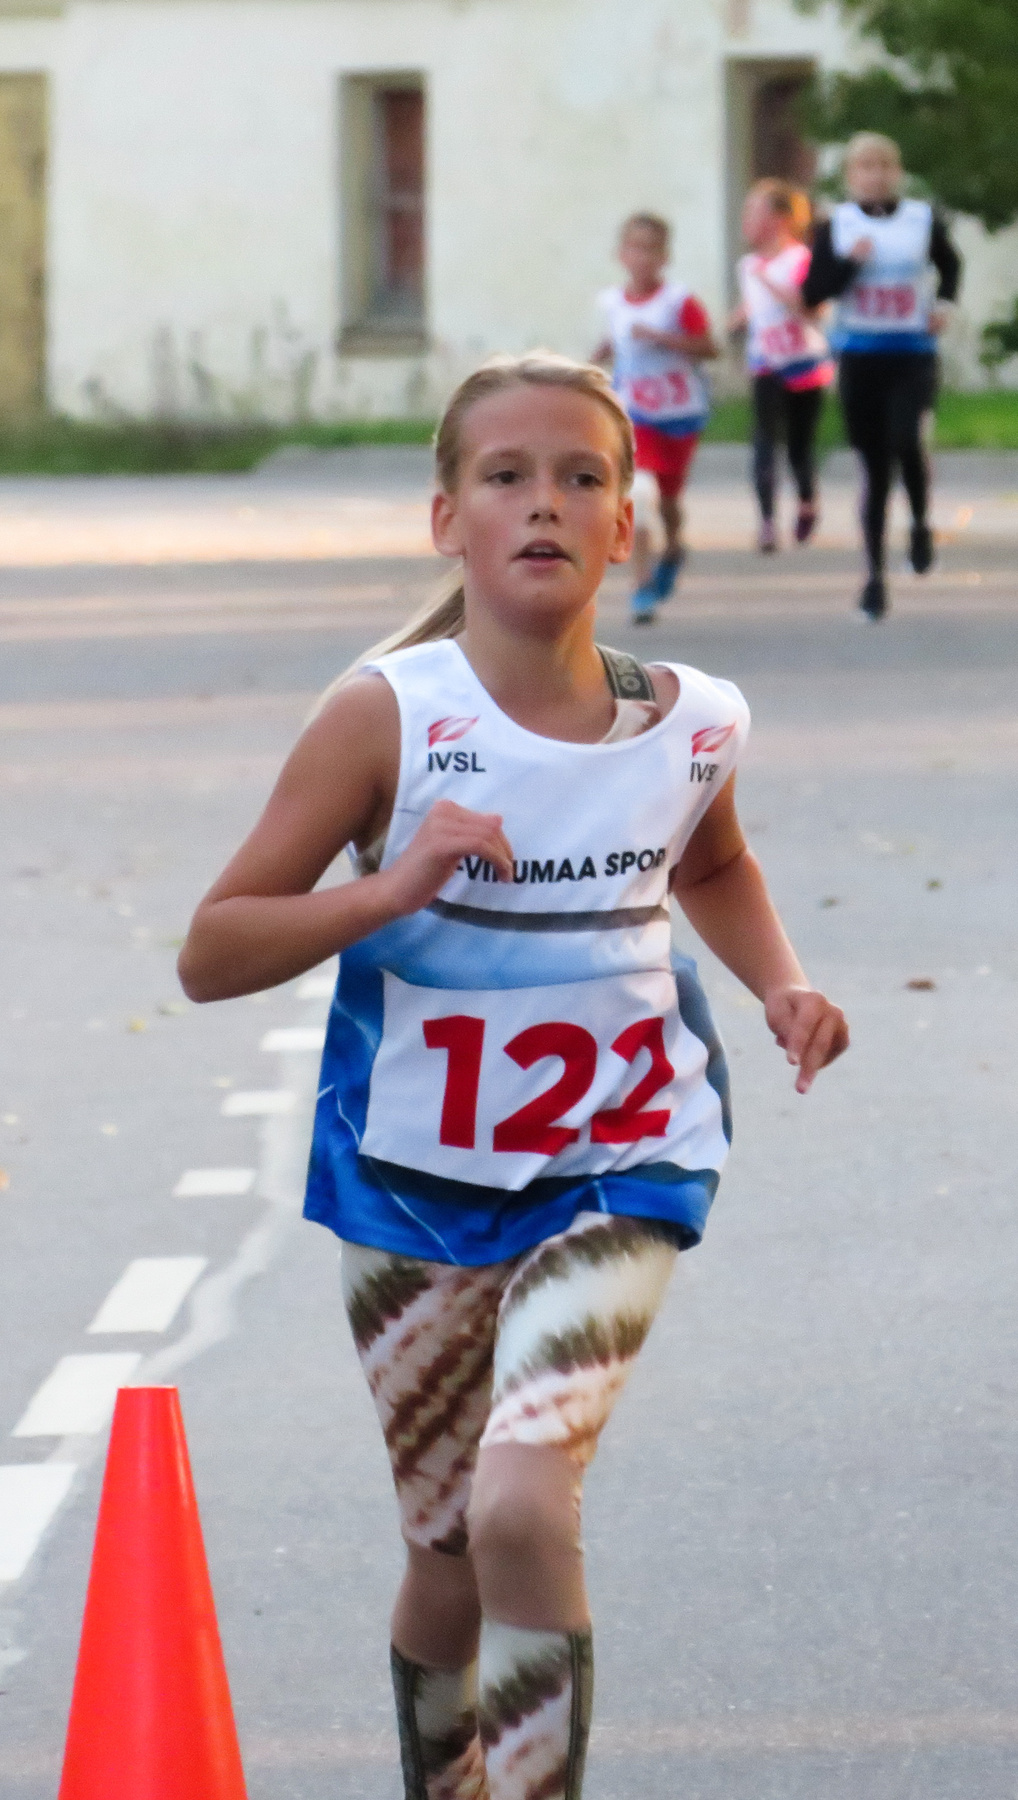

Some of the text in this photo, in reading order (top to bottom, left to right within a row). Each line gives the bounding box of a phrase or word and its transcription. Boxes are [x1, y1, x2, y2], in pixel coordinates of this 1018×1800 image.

[427, 751, 486, 773] IVSL
[456, 855, 596, 884] -VIUMAA
[422, 1015, 676, 1156] 122
